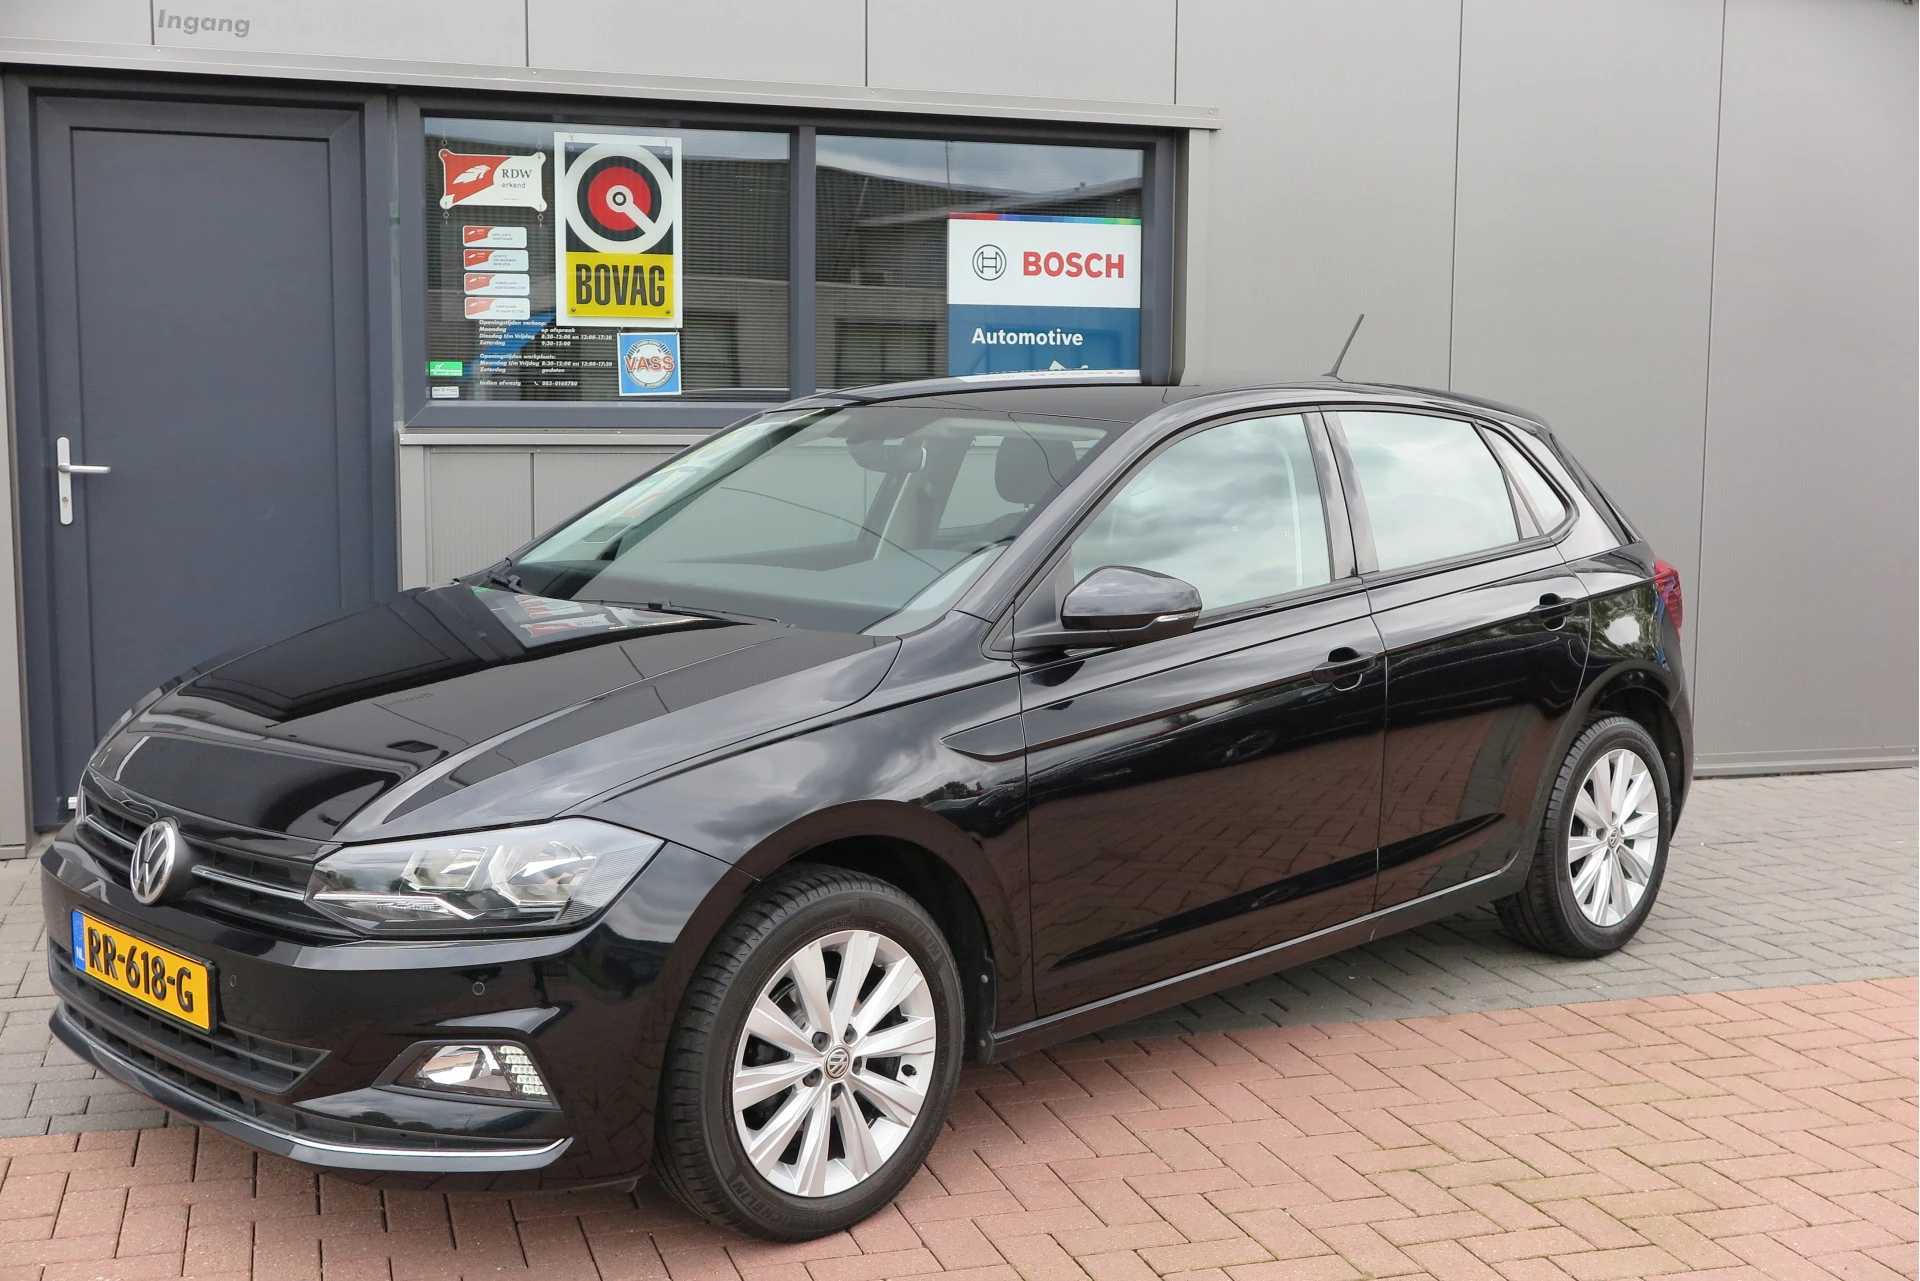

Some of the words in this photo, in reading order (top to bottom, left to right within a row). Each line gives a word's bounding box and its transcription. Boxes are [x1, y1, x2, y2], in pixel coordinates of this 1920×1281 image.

[158, 9, 250, 38] Ingang
[502, 169, 532, 179] RDW
[1023, 251, 1124, 278] BOSCH
[576, 264, 665, 306] BOVAG
[971, 327, 1084, 346] Automotive
[624, 355, 675, 372] VASS
[75, 946, 85, 961] NL
[88, 927, 194, 1012] RR-618-G
